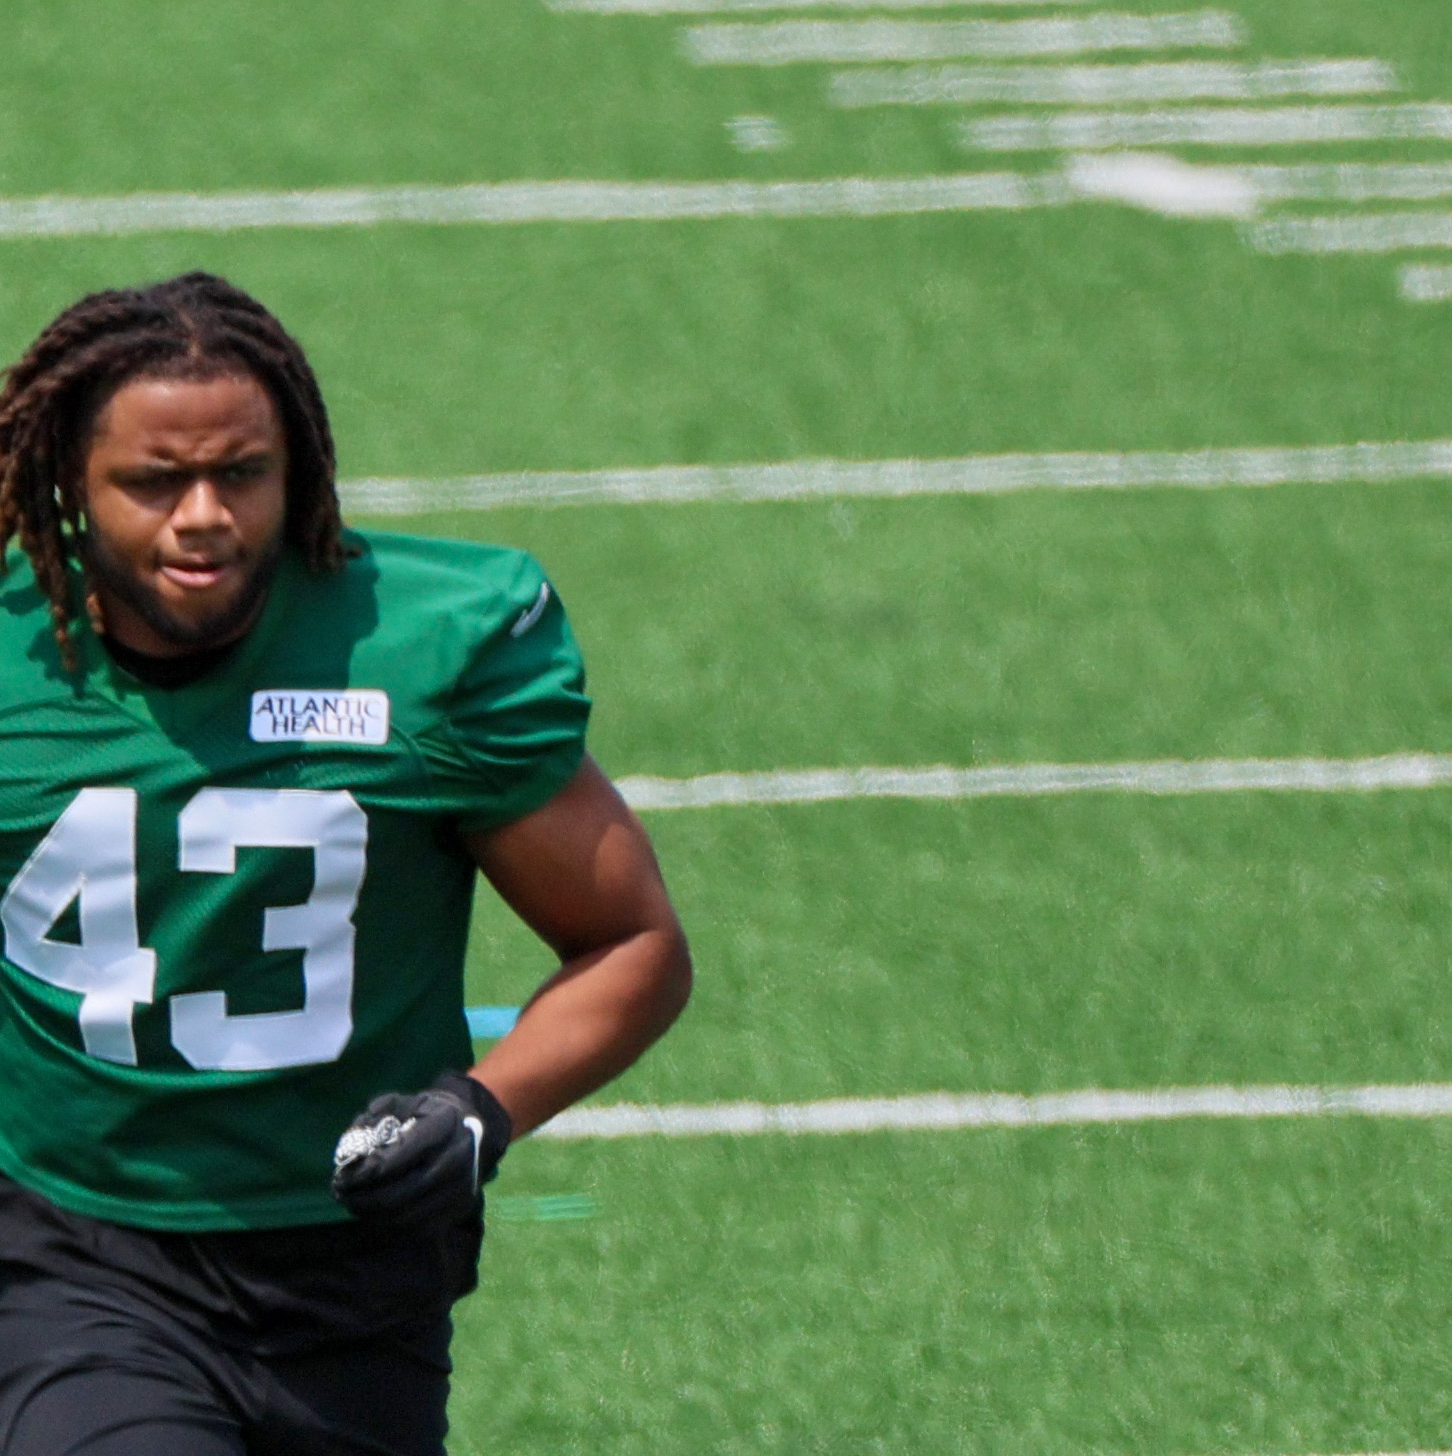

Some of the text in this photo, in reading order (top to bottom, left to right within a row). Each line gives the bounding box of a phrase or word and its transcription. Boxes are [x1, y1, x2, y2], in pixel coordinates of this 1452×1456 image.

[256, 696, 381, 718] ATLANTIC
[271, 715, 365, 736] HEALTH
[0, 787, 368, 1070] 43
